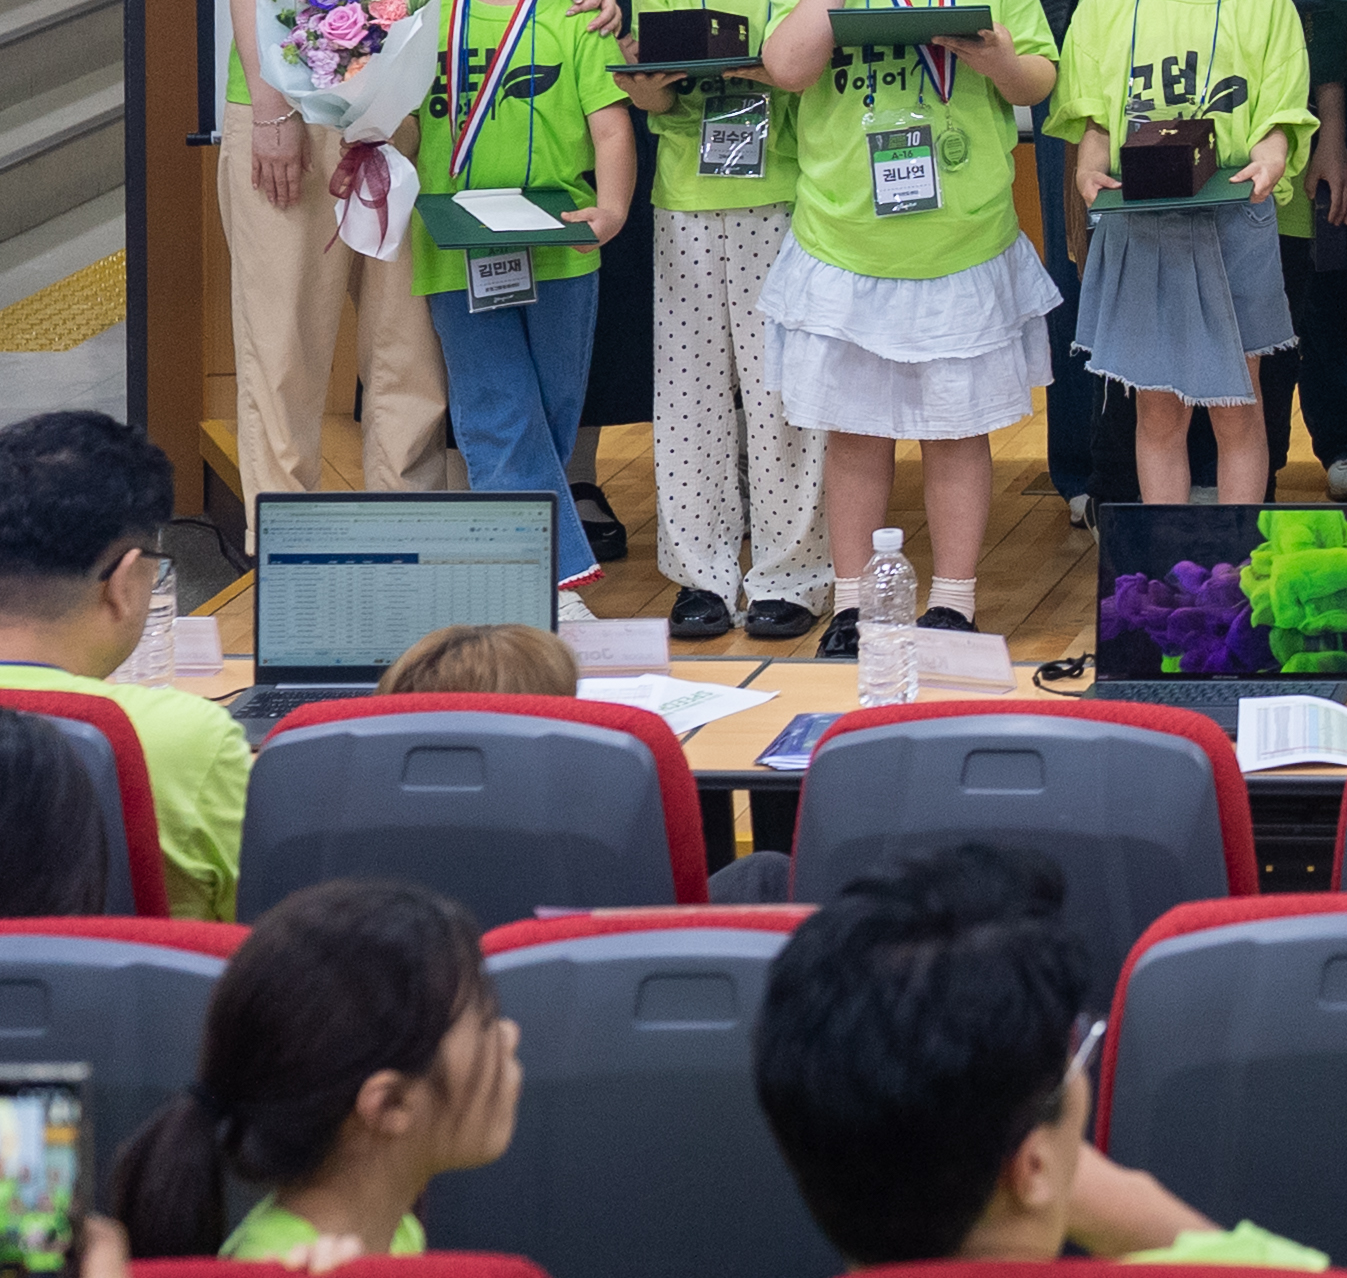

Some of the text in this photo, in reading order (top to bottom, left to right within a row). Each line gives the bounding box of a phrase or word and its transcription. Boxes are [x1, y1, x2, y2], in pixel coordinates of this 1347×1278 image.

[852, 66, 906, 108] 영어
[906, 131, 921, 146] 10
[891, 150, 914, 160] A-16
[883, 165, 925, 182] 권나연
[479, 259, 521, 278] 김민재
